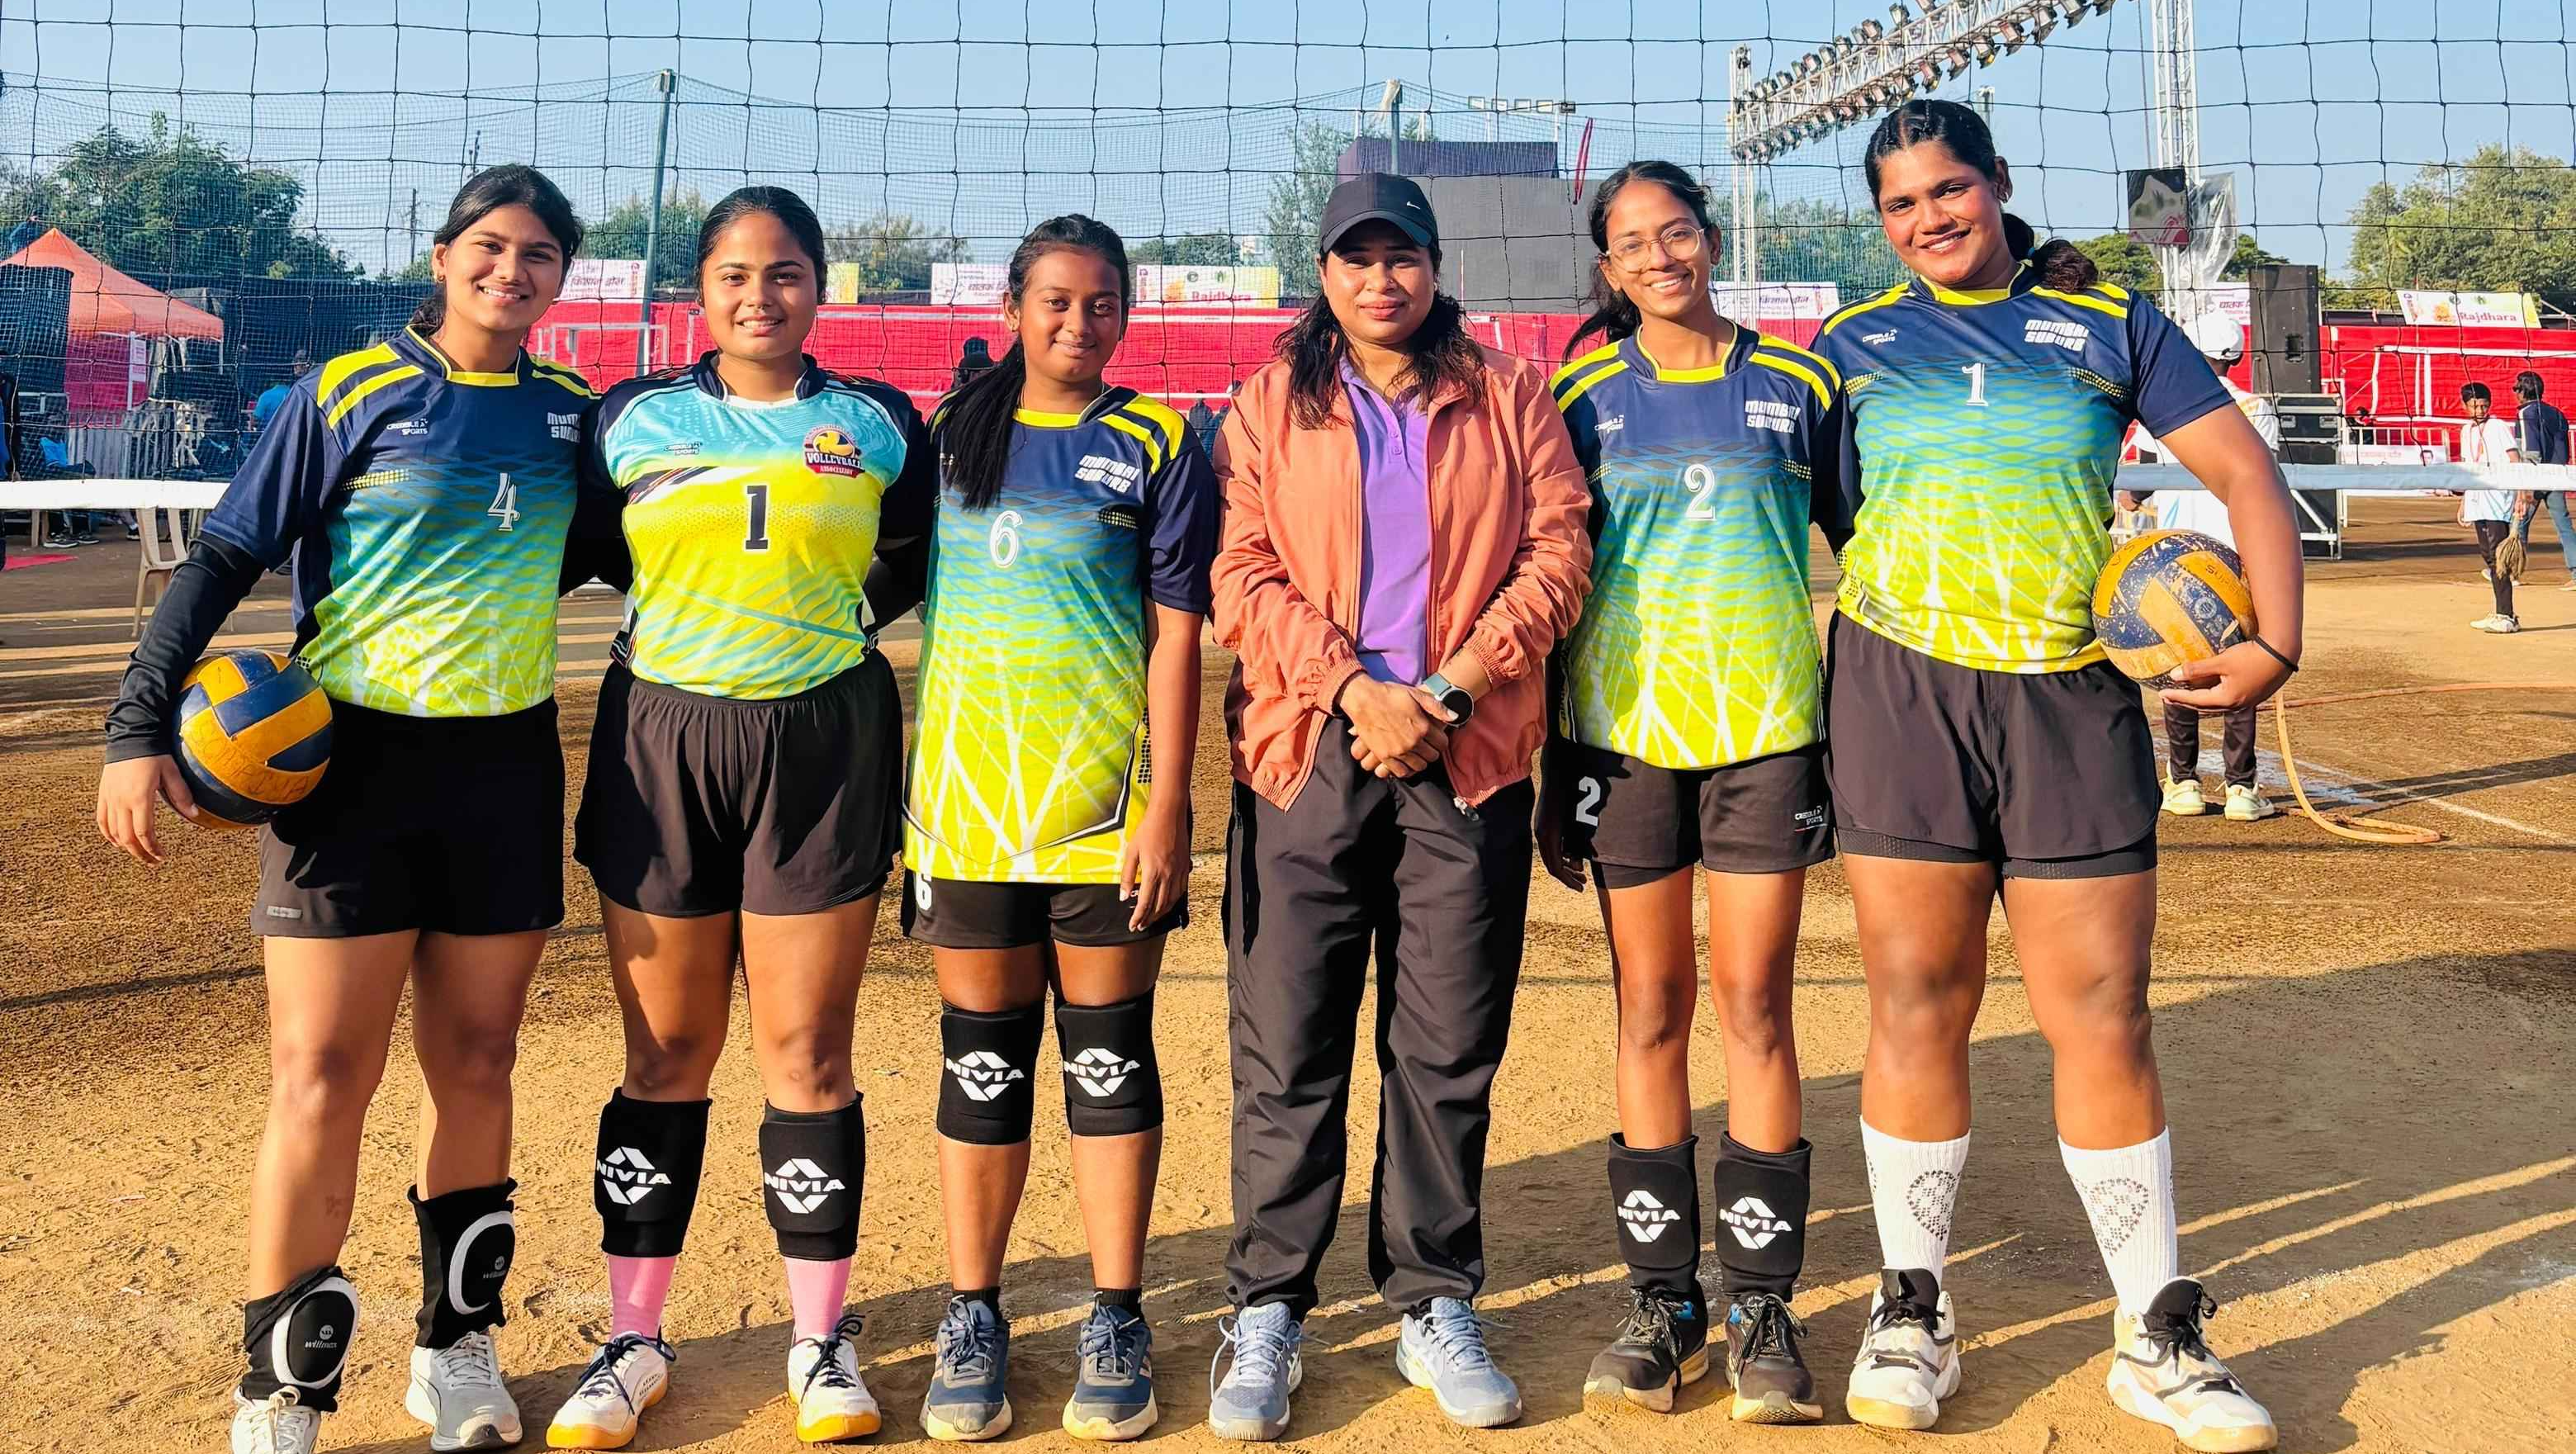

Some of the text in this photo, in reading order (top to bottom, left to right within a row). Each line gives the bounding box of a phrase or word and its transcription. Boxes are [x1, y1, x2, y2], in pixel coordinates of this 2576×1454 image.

[2459, 311, 2517, 324] Rajdhara
[1962, 362, 1989, 407] 1
[806, 452, 866, 471] VOLLEYBALL
[487, 472, 521, 531] 4
[1683, 463, 1717, 521] 2
[744, 484, 769, 551] 1
[989, 509, 1023, 568] 6
[1575, 775, 1602, 826] 2
[915, 871, 933, 911] 6
[945, 1057, 1025, 1082] NIVIA
[1063, 1059, 1140, 1078] NIVIA
[596, 1159, 672, 1186] NIVIA
[765, 1171, 846, 1194] NIVIA
[1617, 1205, 1681, 1222] NIVIA
[1720, 1208, 1792, 1232] NIVIA
